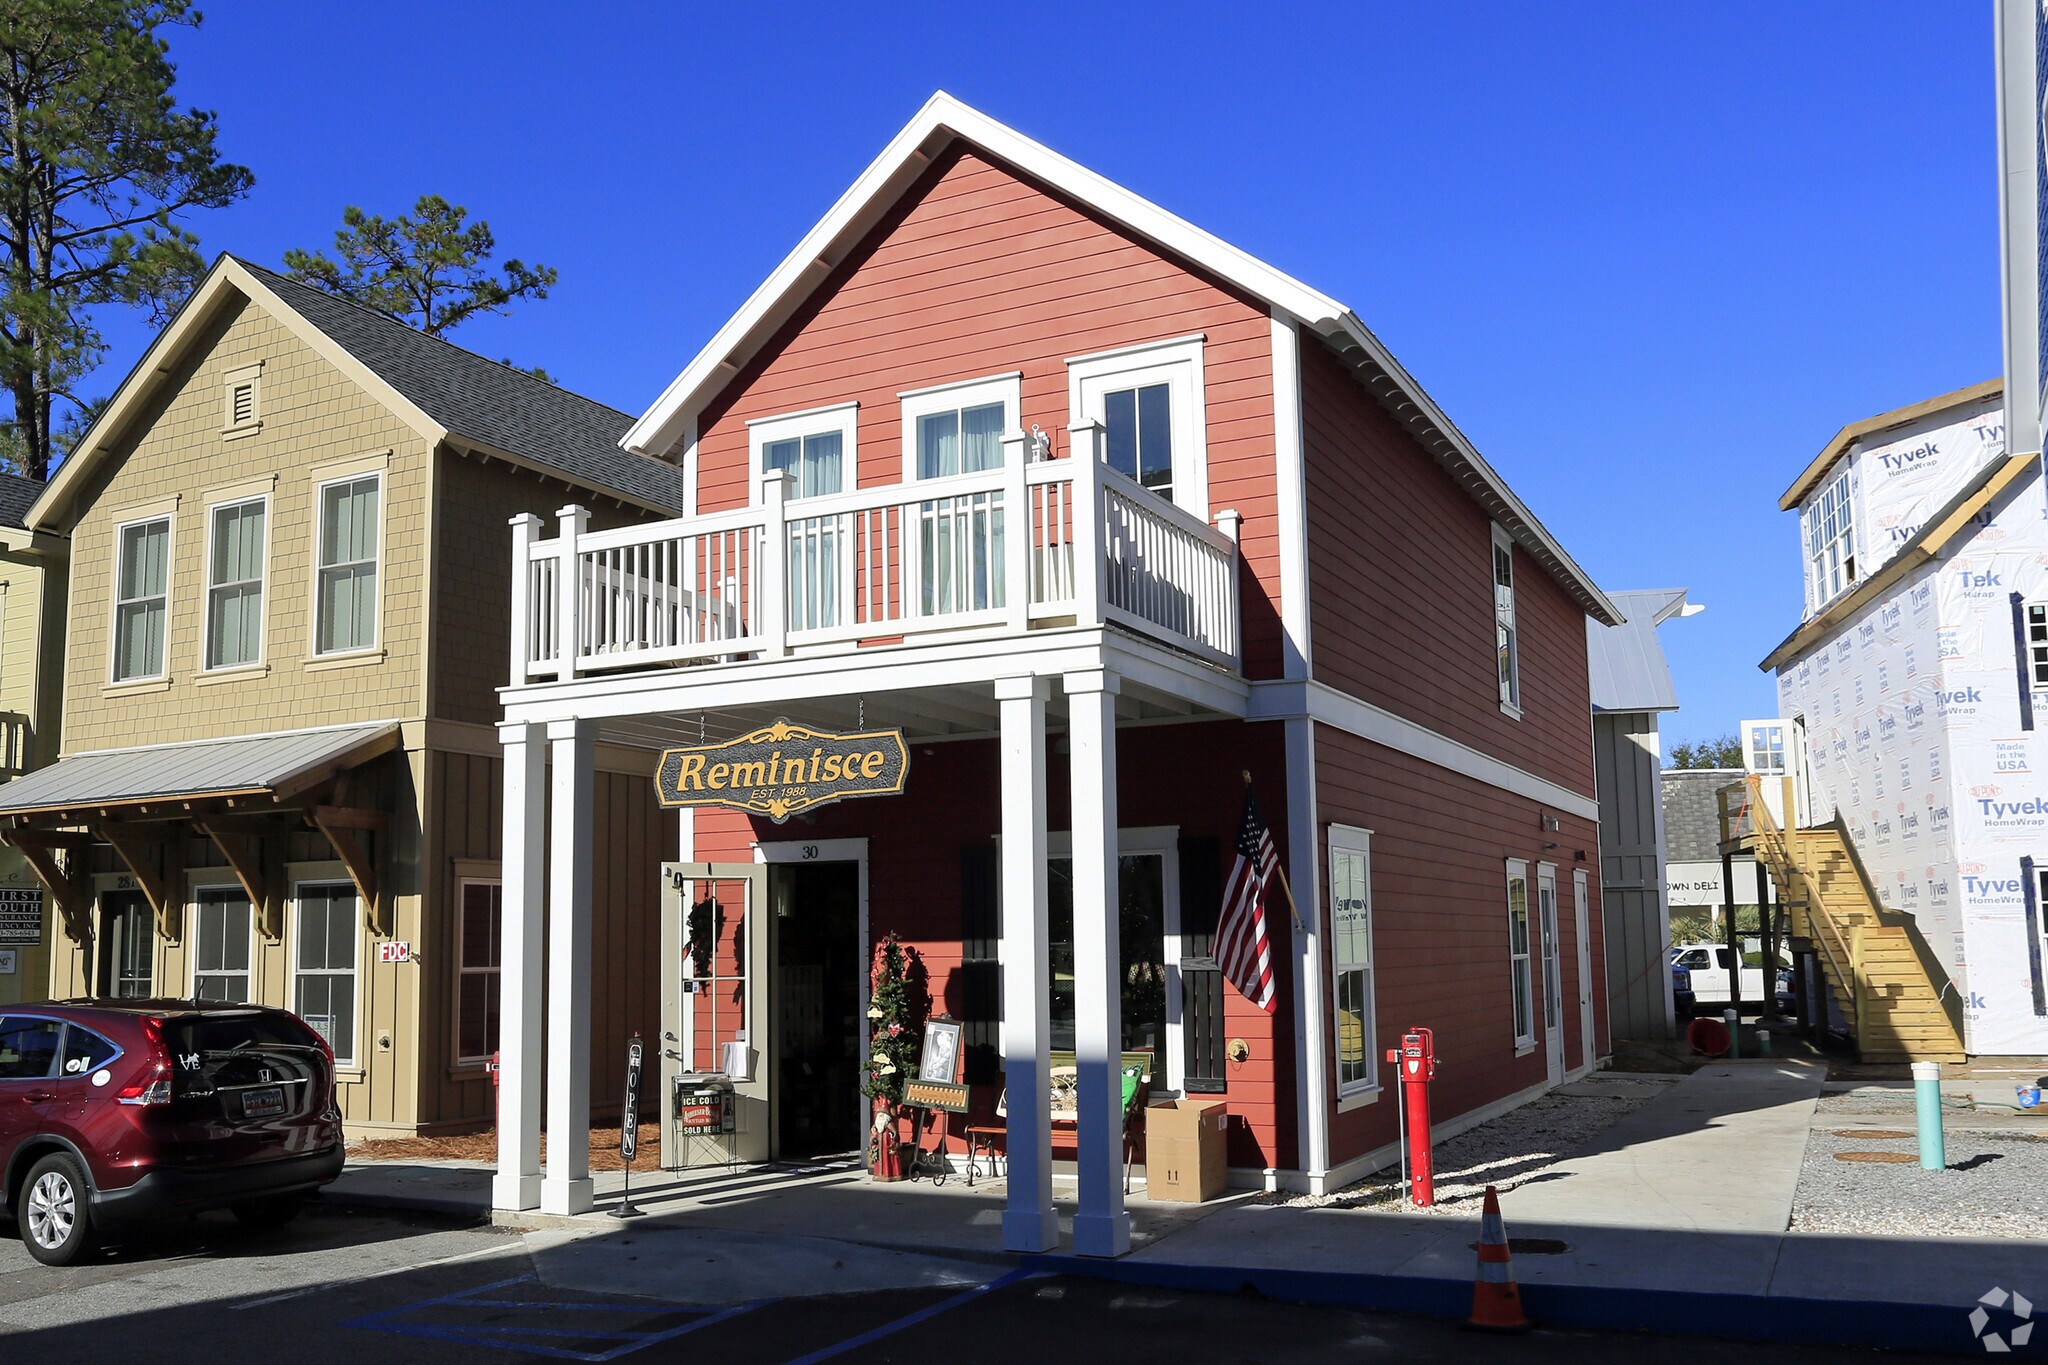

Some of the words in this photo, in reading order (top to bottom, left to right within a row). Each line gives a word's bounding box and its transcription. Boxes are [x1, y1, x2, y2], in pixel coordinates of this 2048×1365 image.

[1878, 442, 1940, 470] Tyvek
[1888, 459, 1938, 478] HomeWrap
[677, 747, 885, 791] Reminisce
[1997, 760, 2027, 770] USA
[751, 789, 775, 799] EST.
[780, 787, 807, 797] 1988
[1977, 797, 2048, 819] Tyvek
[1928, 804, 1949, 826] Tyvek
[1984, 818, 2045, 827] HomeWrap
[802, 846, 818, 860] 30
[1694, 882, 1718, 890] DELI
[1, 891, 40, 901] IRST
[0, 903, 39, 912] OUTH
[382, 943, 406, 960] FDC
[683, 1097, 696, 1106] ICE
[699, 1096, 719, 1105] COLD
[624, 1072, 637, 1150] OPEN
[684, 1126, 701, 1135] SOLD
[703, 1125, 720, 1133] HERE
